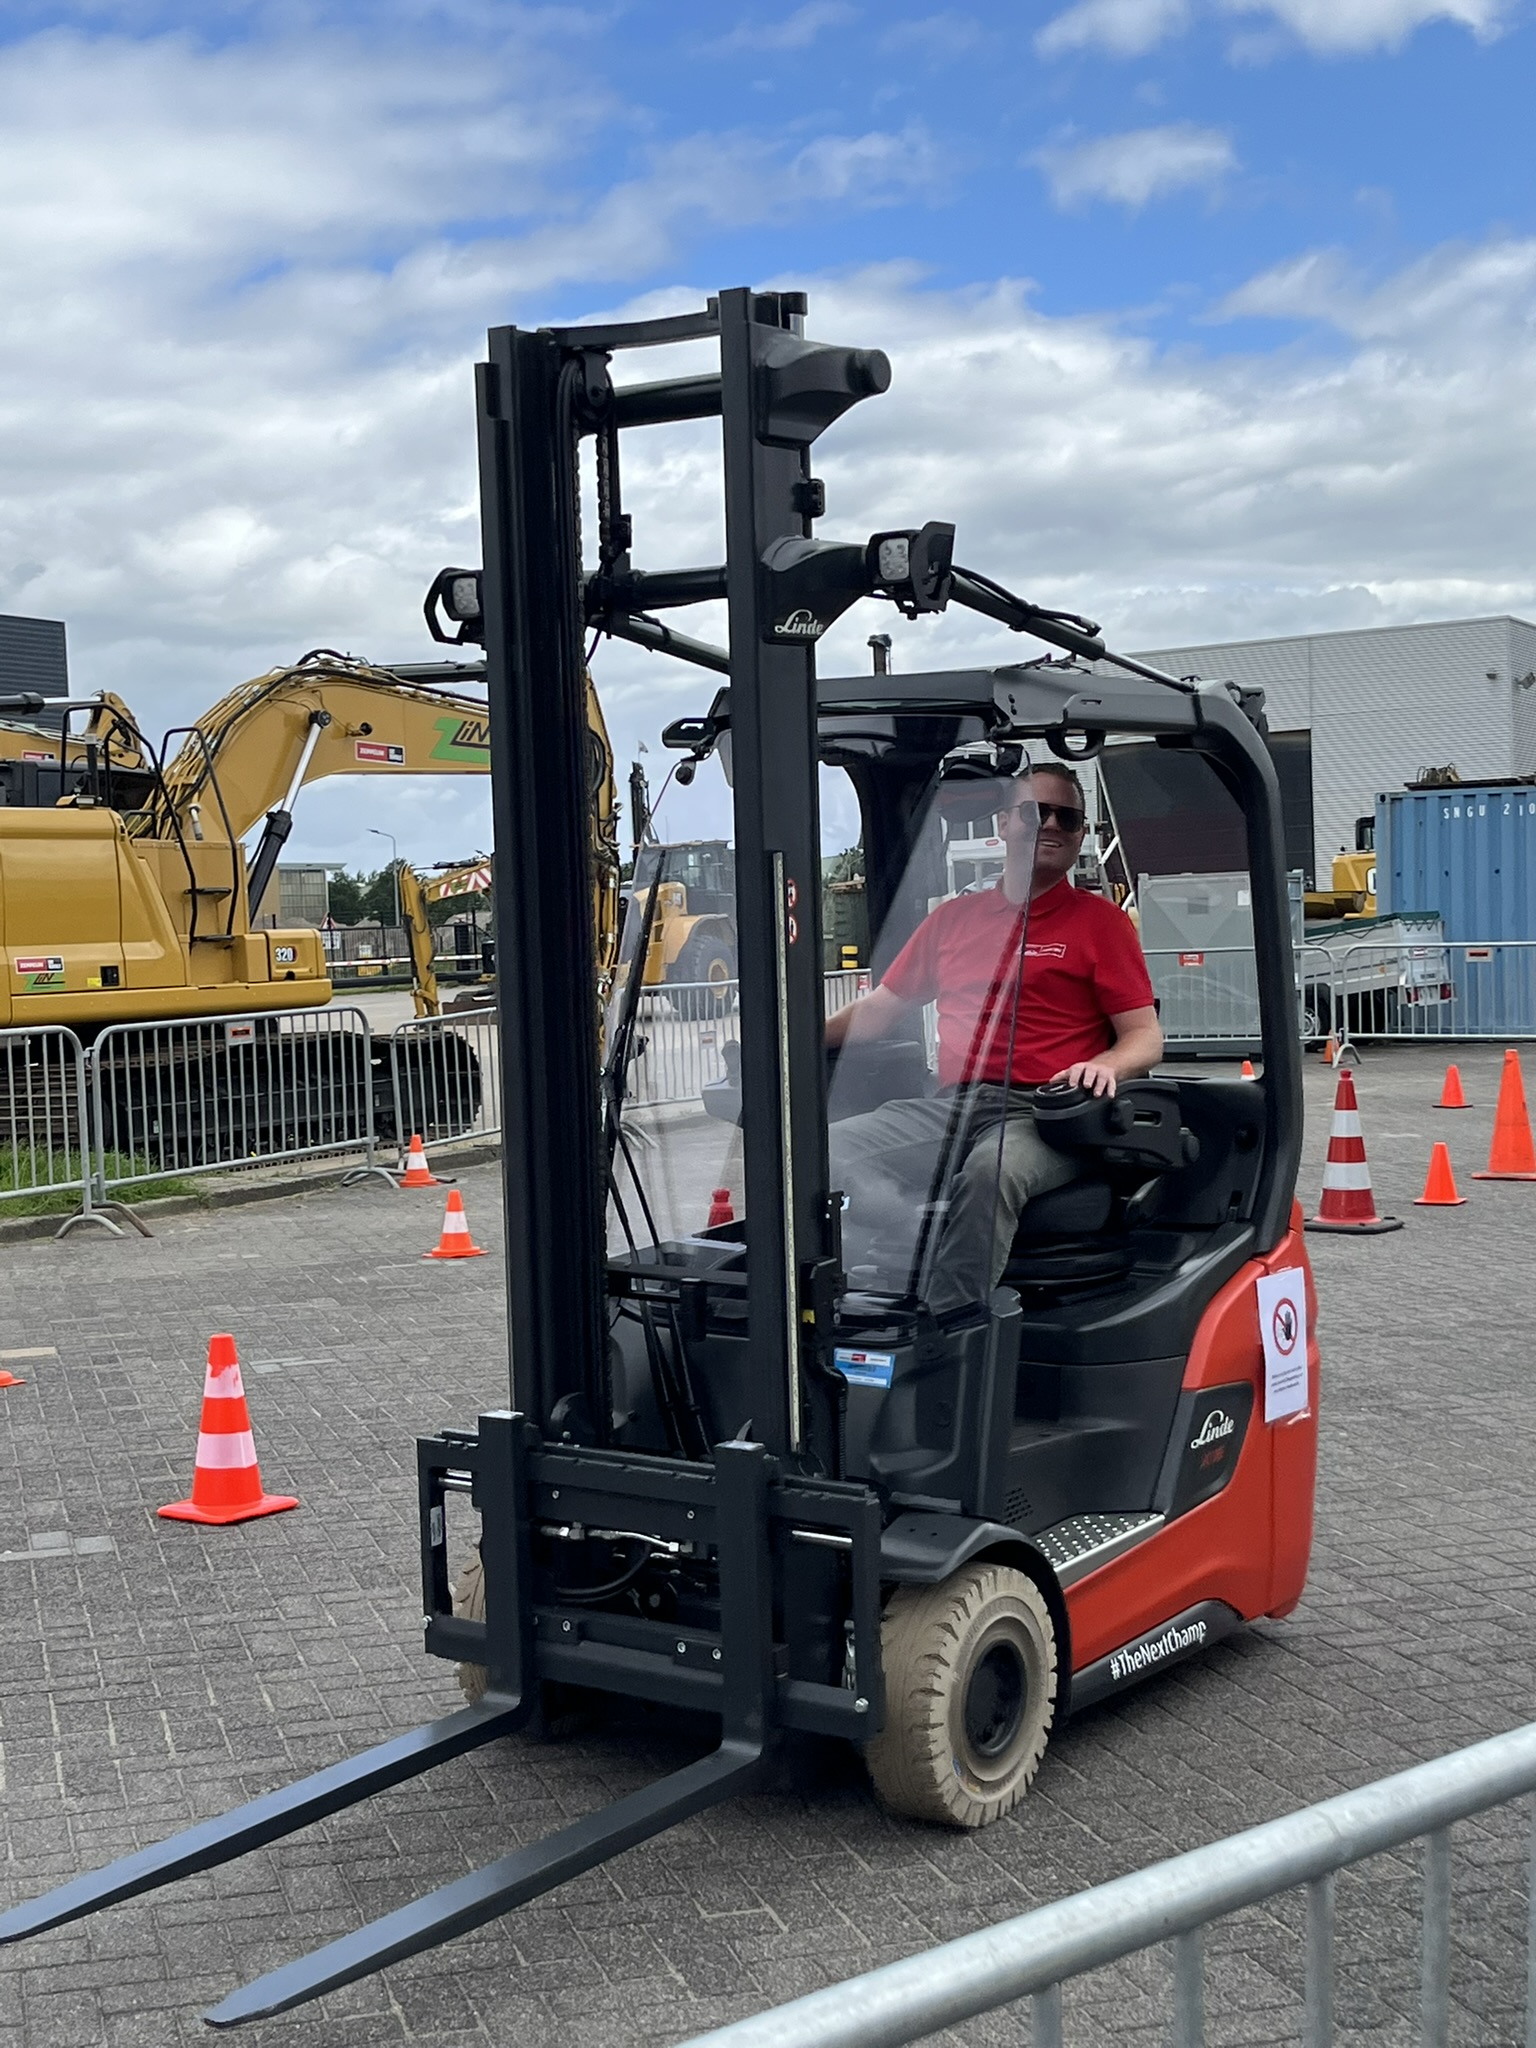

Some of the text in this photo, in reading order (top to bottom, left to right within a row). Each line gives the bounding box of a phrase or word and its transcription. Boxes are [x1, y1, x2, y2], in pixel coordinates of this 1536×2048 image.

[774, 609, 823, 635] Linde
[1443, 805, 1486, 819] SNGU
[275, 947, 293, 962] 320
[1190, 1410, 1234, 1449] Linde
[1110, 1621, 1206, 1680] #TheNextChamp
